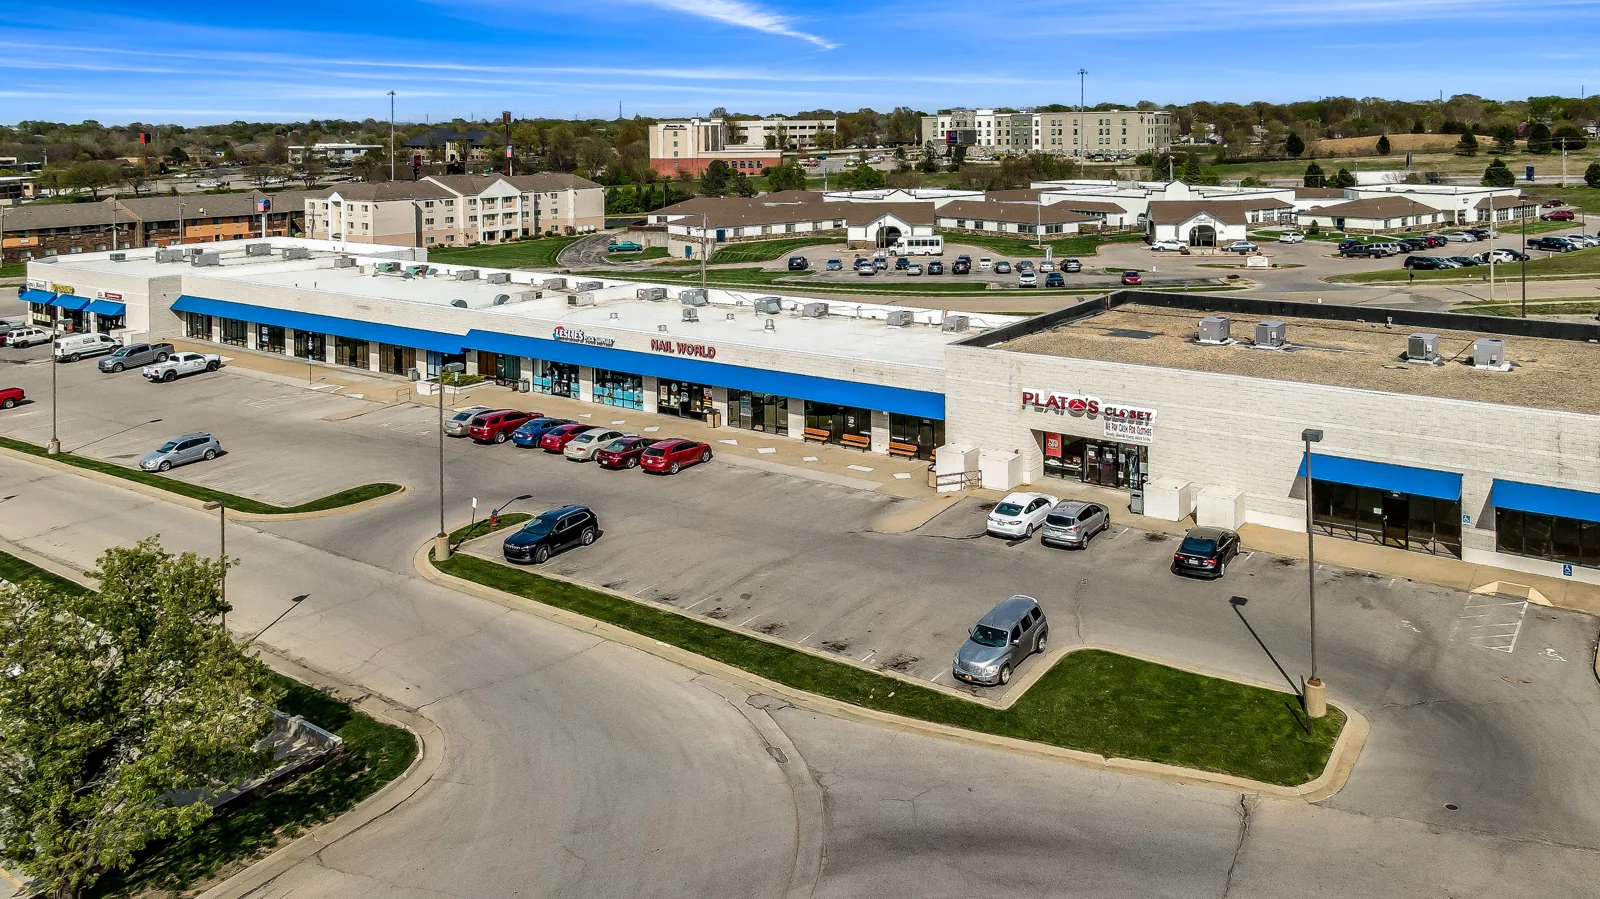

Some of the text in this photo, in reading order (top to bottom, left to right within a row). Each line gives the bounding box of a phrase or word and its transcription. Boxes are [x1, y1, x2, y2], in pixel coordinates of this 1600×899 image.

[555, 329, 584, 342] LESLIE'S
[651, 339, 716, 359] NAIL WORLD
[1022, 391, 1152, 421] PLATO'S CLOSET
[1119, 423, 1128, 433] CASH
